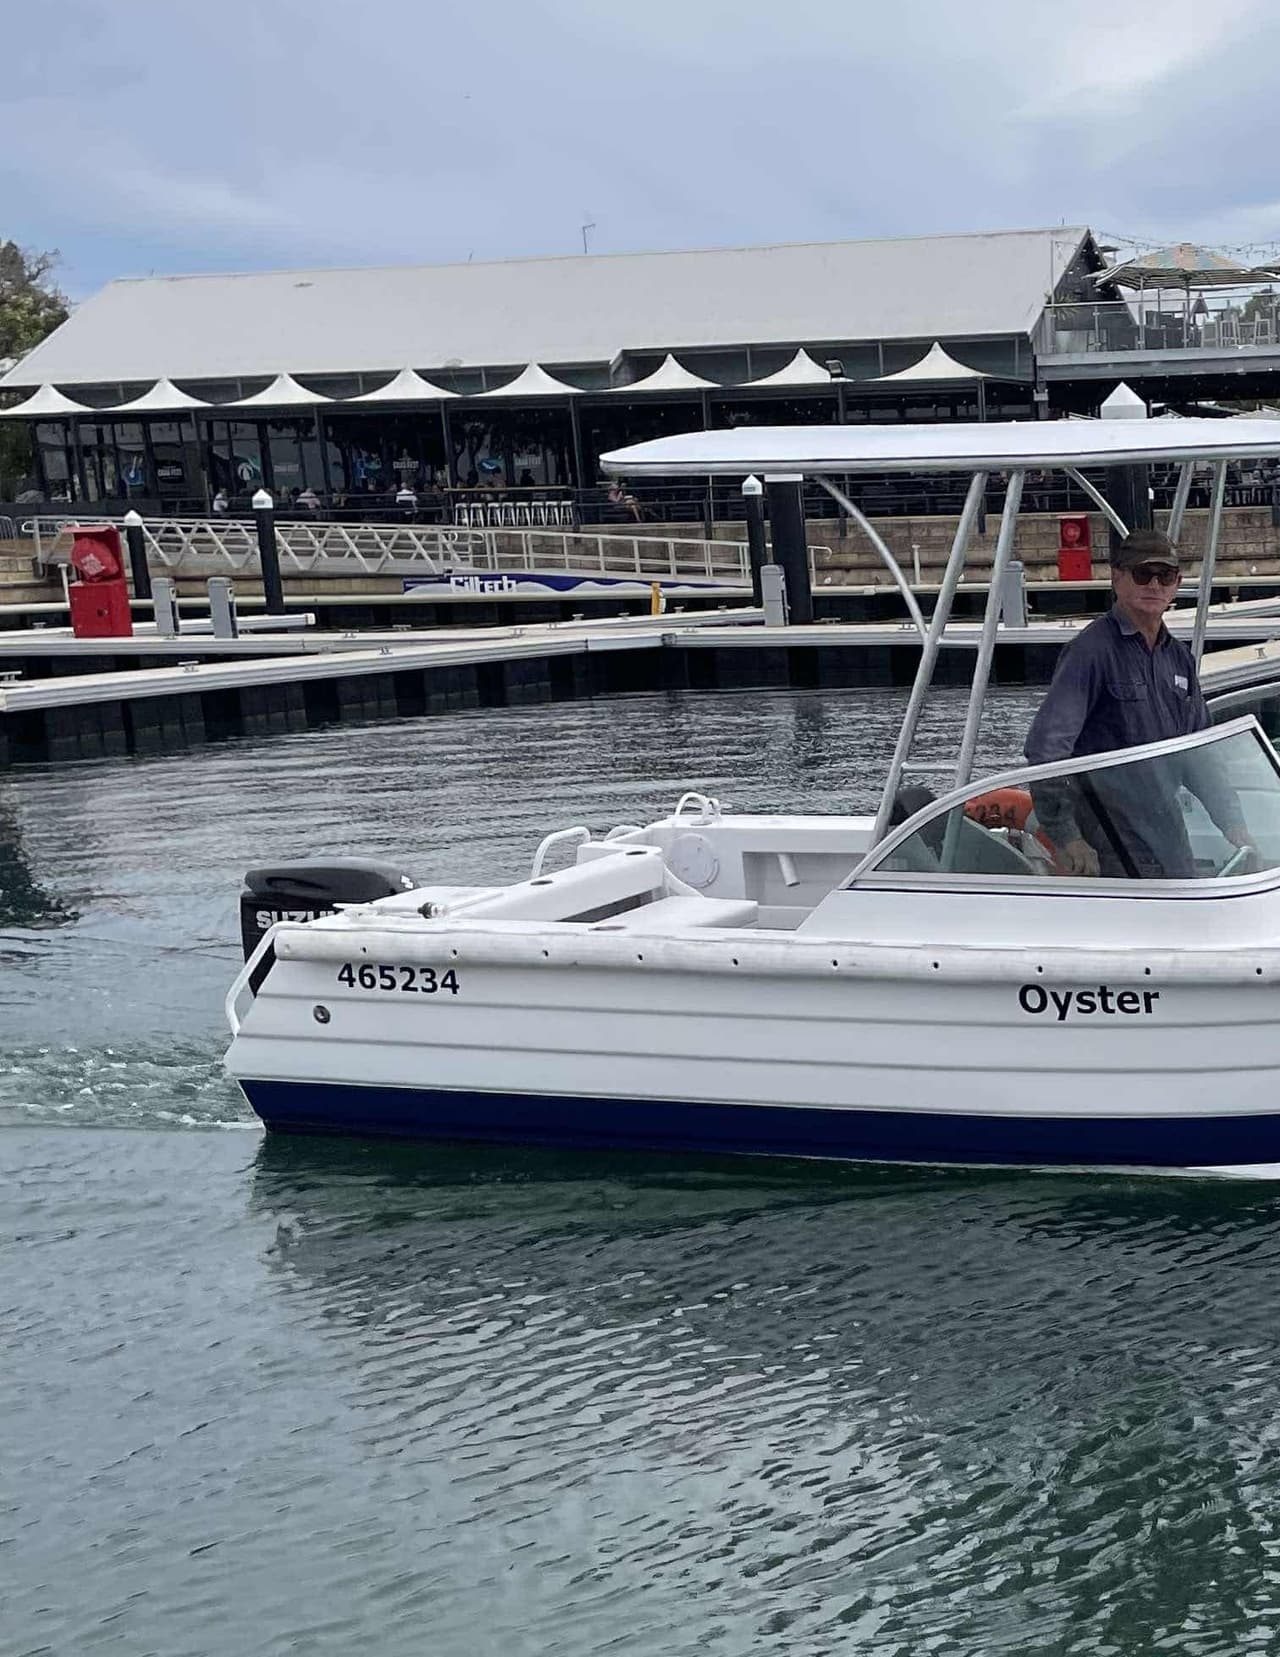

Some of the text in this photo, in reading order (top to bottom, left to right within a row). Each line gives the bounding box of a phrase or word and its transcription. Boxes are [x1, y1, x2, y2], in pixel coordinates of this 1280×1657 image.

[255, 910, 336, 929] SUZU
[337, 962, 460, 995] 465234
[1018, 983, 1160, 1021] Oyster
